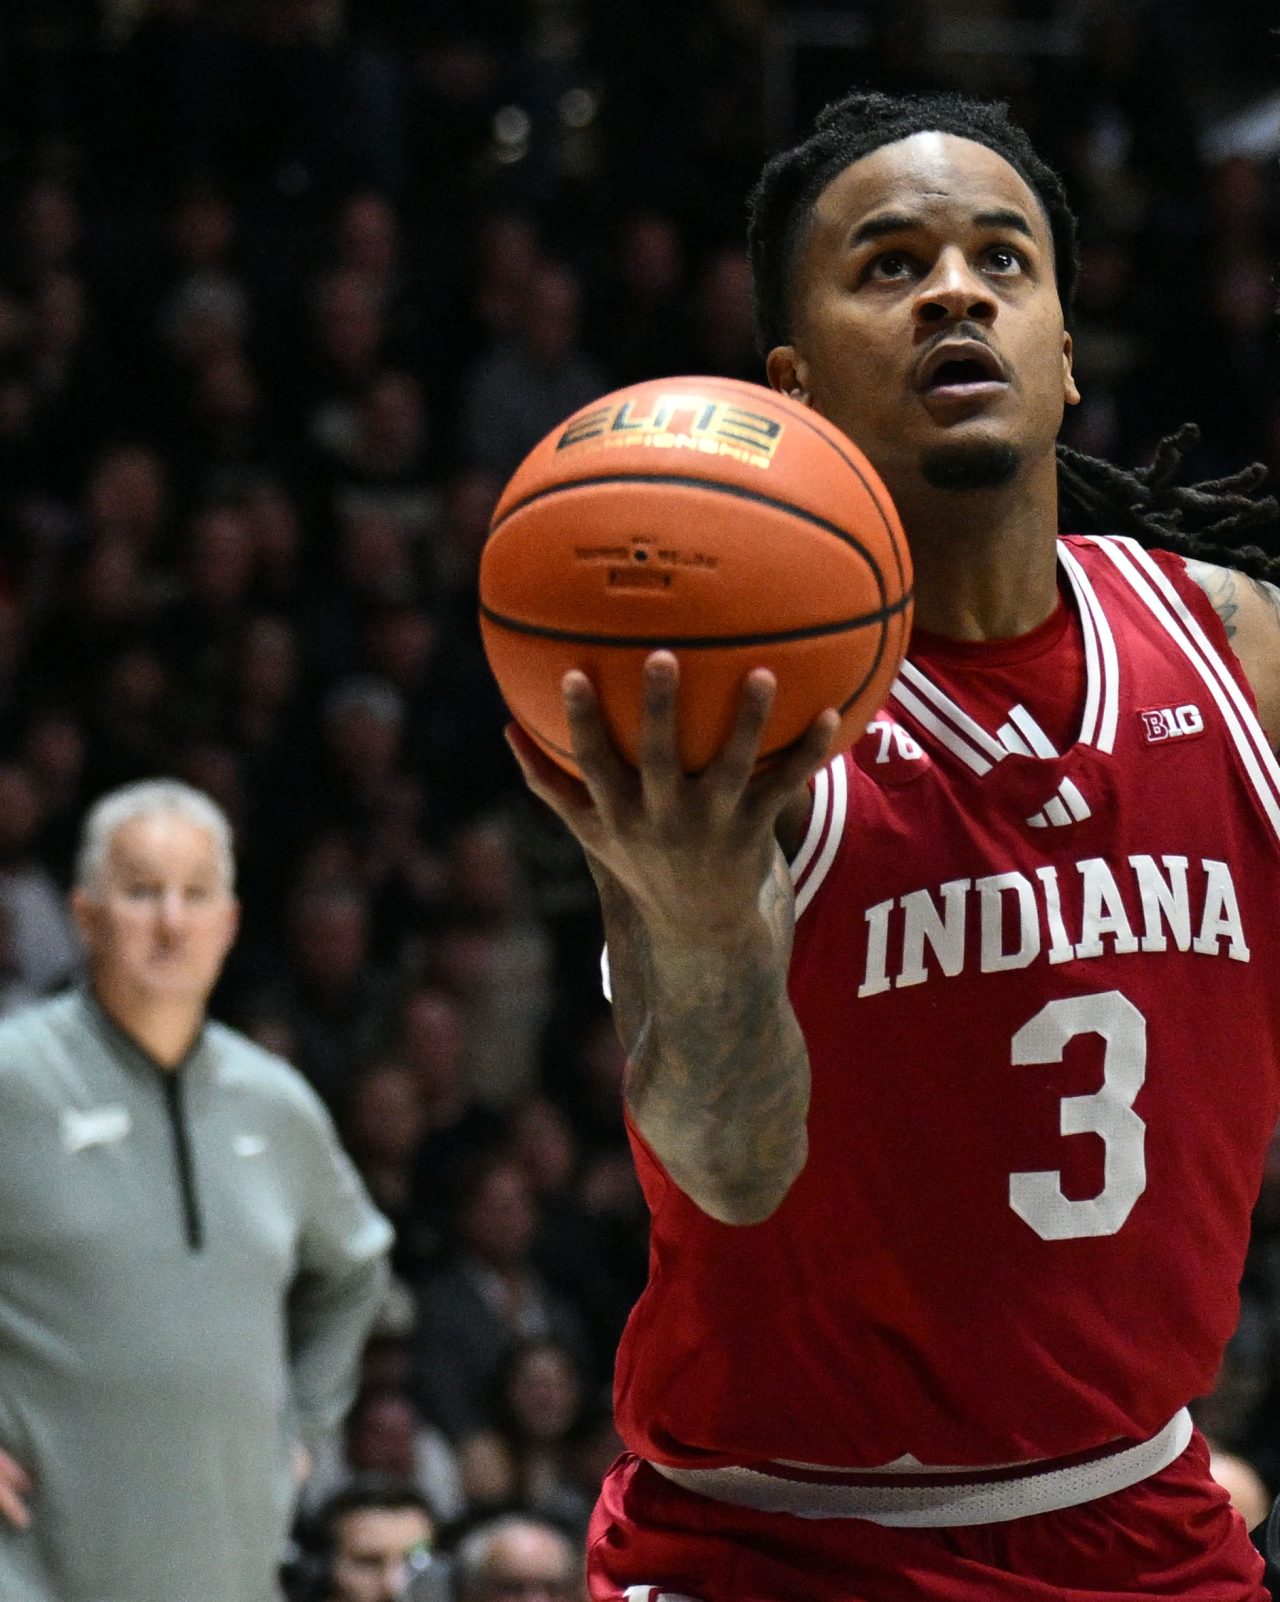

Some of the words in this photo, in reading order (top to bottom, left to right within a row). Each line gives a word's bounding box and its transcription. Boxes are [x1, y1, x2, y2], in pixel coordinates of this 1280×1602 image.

[568, 432, 771, 470] MPIONSHIP
[858, 854, 1250, 998] INDIANA
[1009, 990, 1147, 1240] 3
